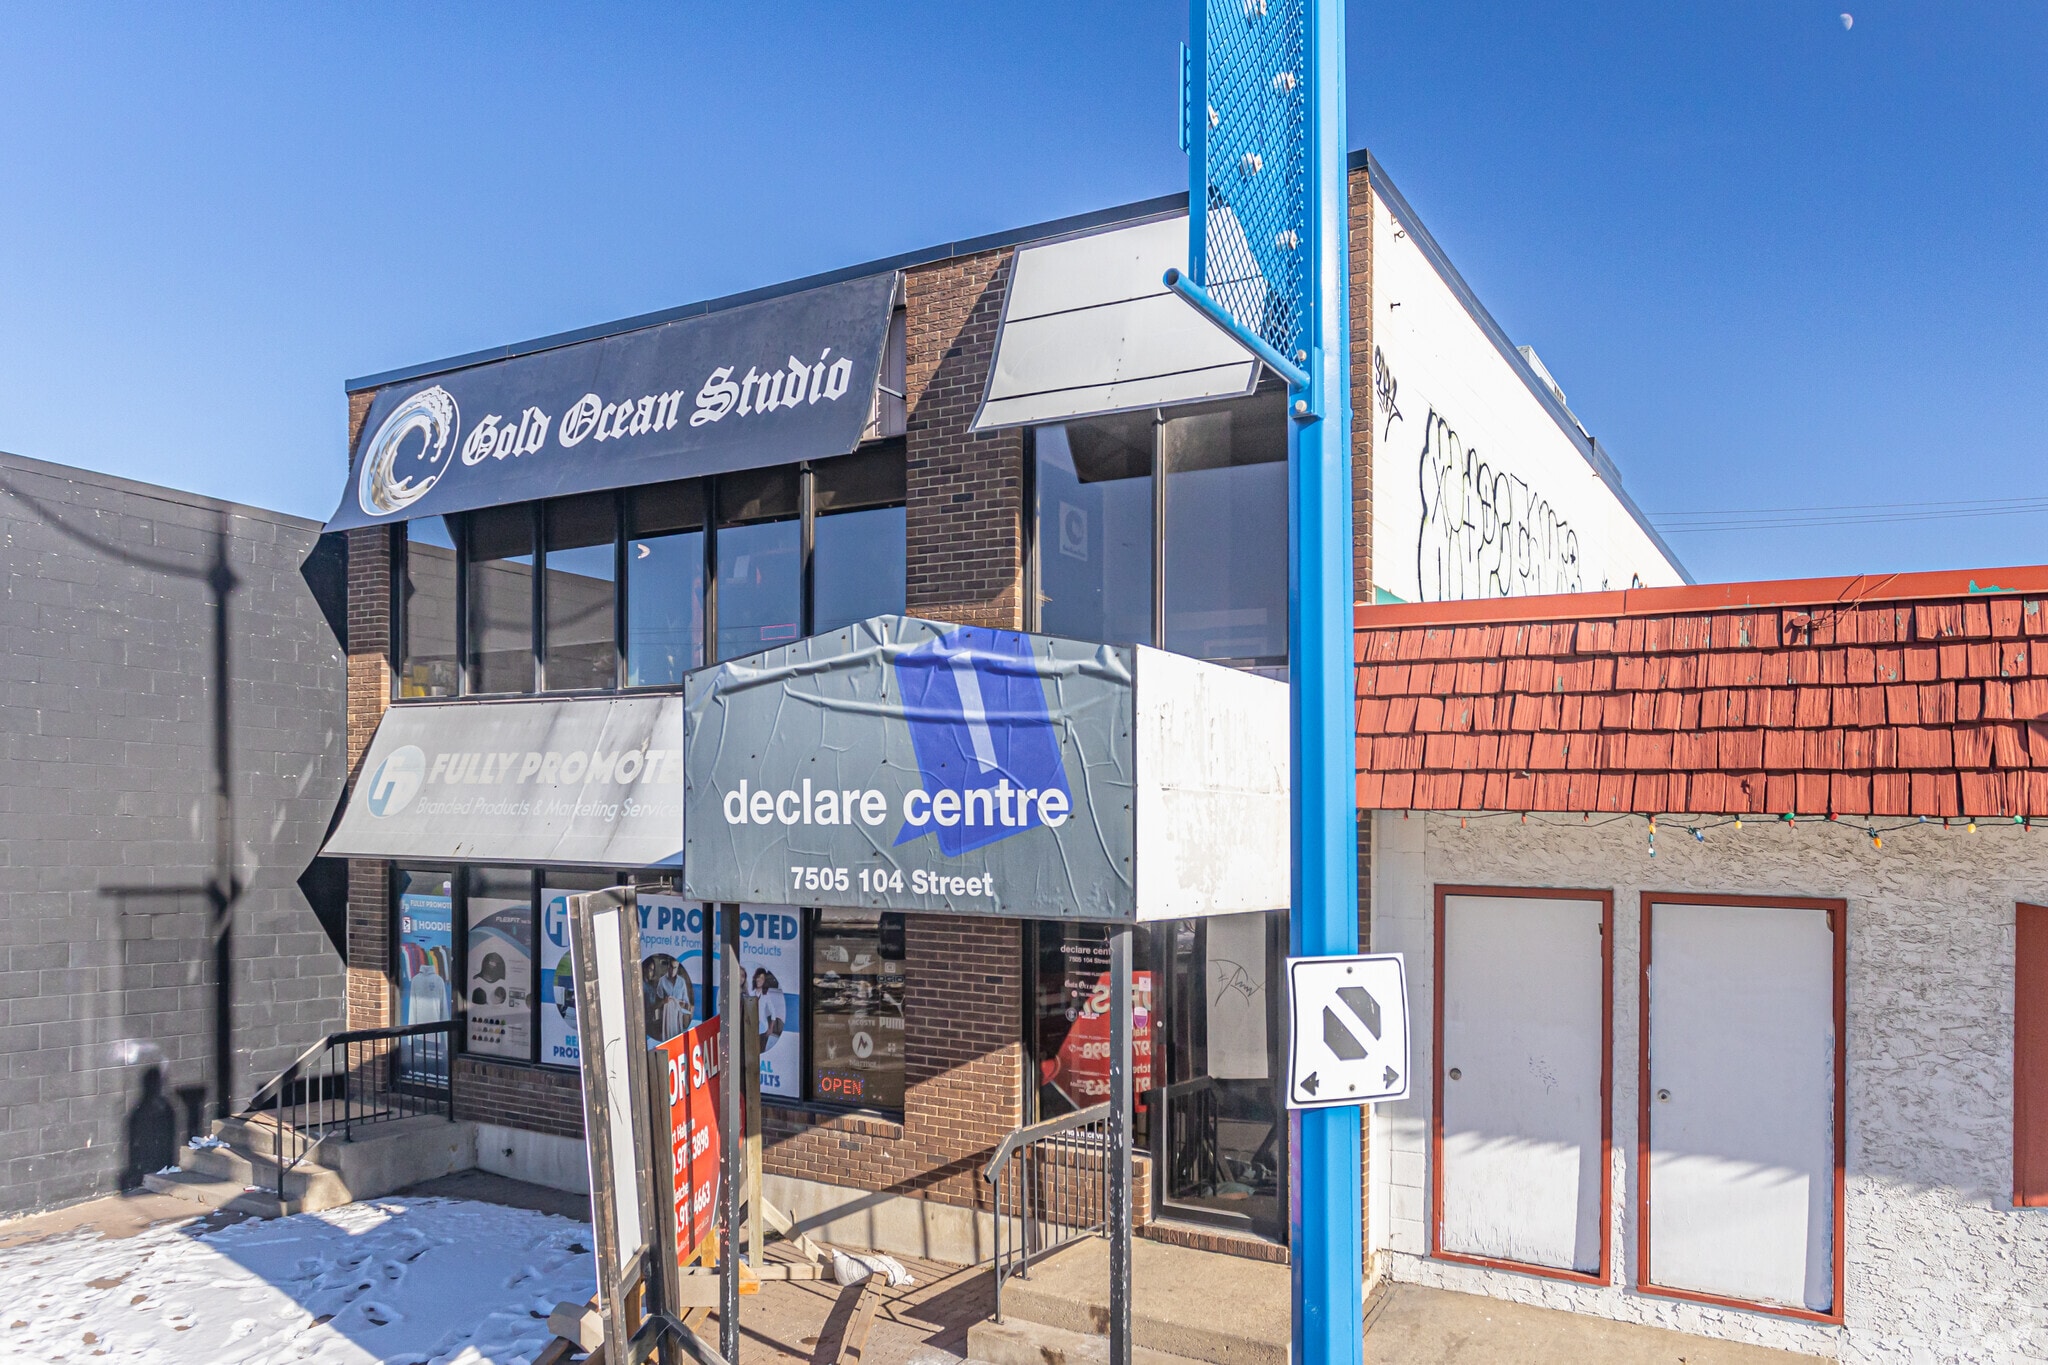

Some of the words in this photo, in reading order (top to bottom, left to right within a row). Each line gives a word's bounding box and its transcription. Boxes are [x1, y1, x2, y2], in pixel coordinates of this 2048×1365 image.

[461, 403, 552, 466] Gold
[558, 390, 685, 448] Ocean
[689, 347, 854, 428] Studio
[426, 751, 523, 785] FULLY
[517, 750, 683, 785] PROMOTE
[416, 797, 474, 816] Branded
[469, 798, 530, 817] Products
[532, 800, 541, 816] &
[544, 799, 618, 822] Marketing
[619, 797, 683, 818] Service
[723, 778, 888, 826] declare
[903, 779, 1070, 827] centre
[790, 866, 849, 891] 7505
[858, 869, 902, 894] 104
[911, 869, 994, 897] Street
[426, 901, 452, 909] PROMOT
[418, 920, 451, 931] HOODIE
[640, 932, 672, 948] Apparel
[674, 936, 681, 946] &
[743, 941, 782, 956] Products
[1060, 945, 1091, 954] declare
[553, 1045, 580, 1058] PROD
[669, 1053, 689, 1106] OR
[821, 1076, 863, 1096] OPEN
